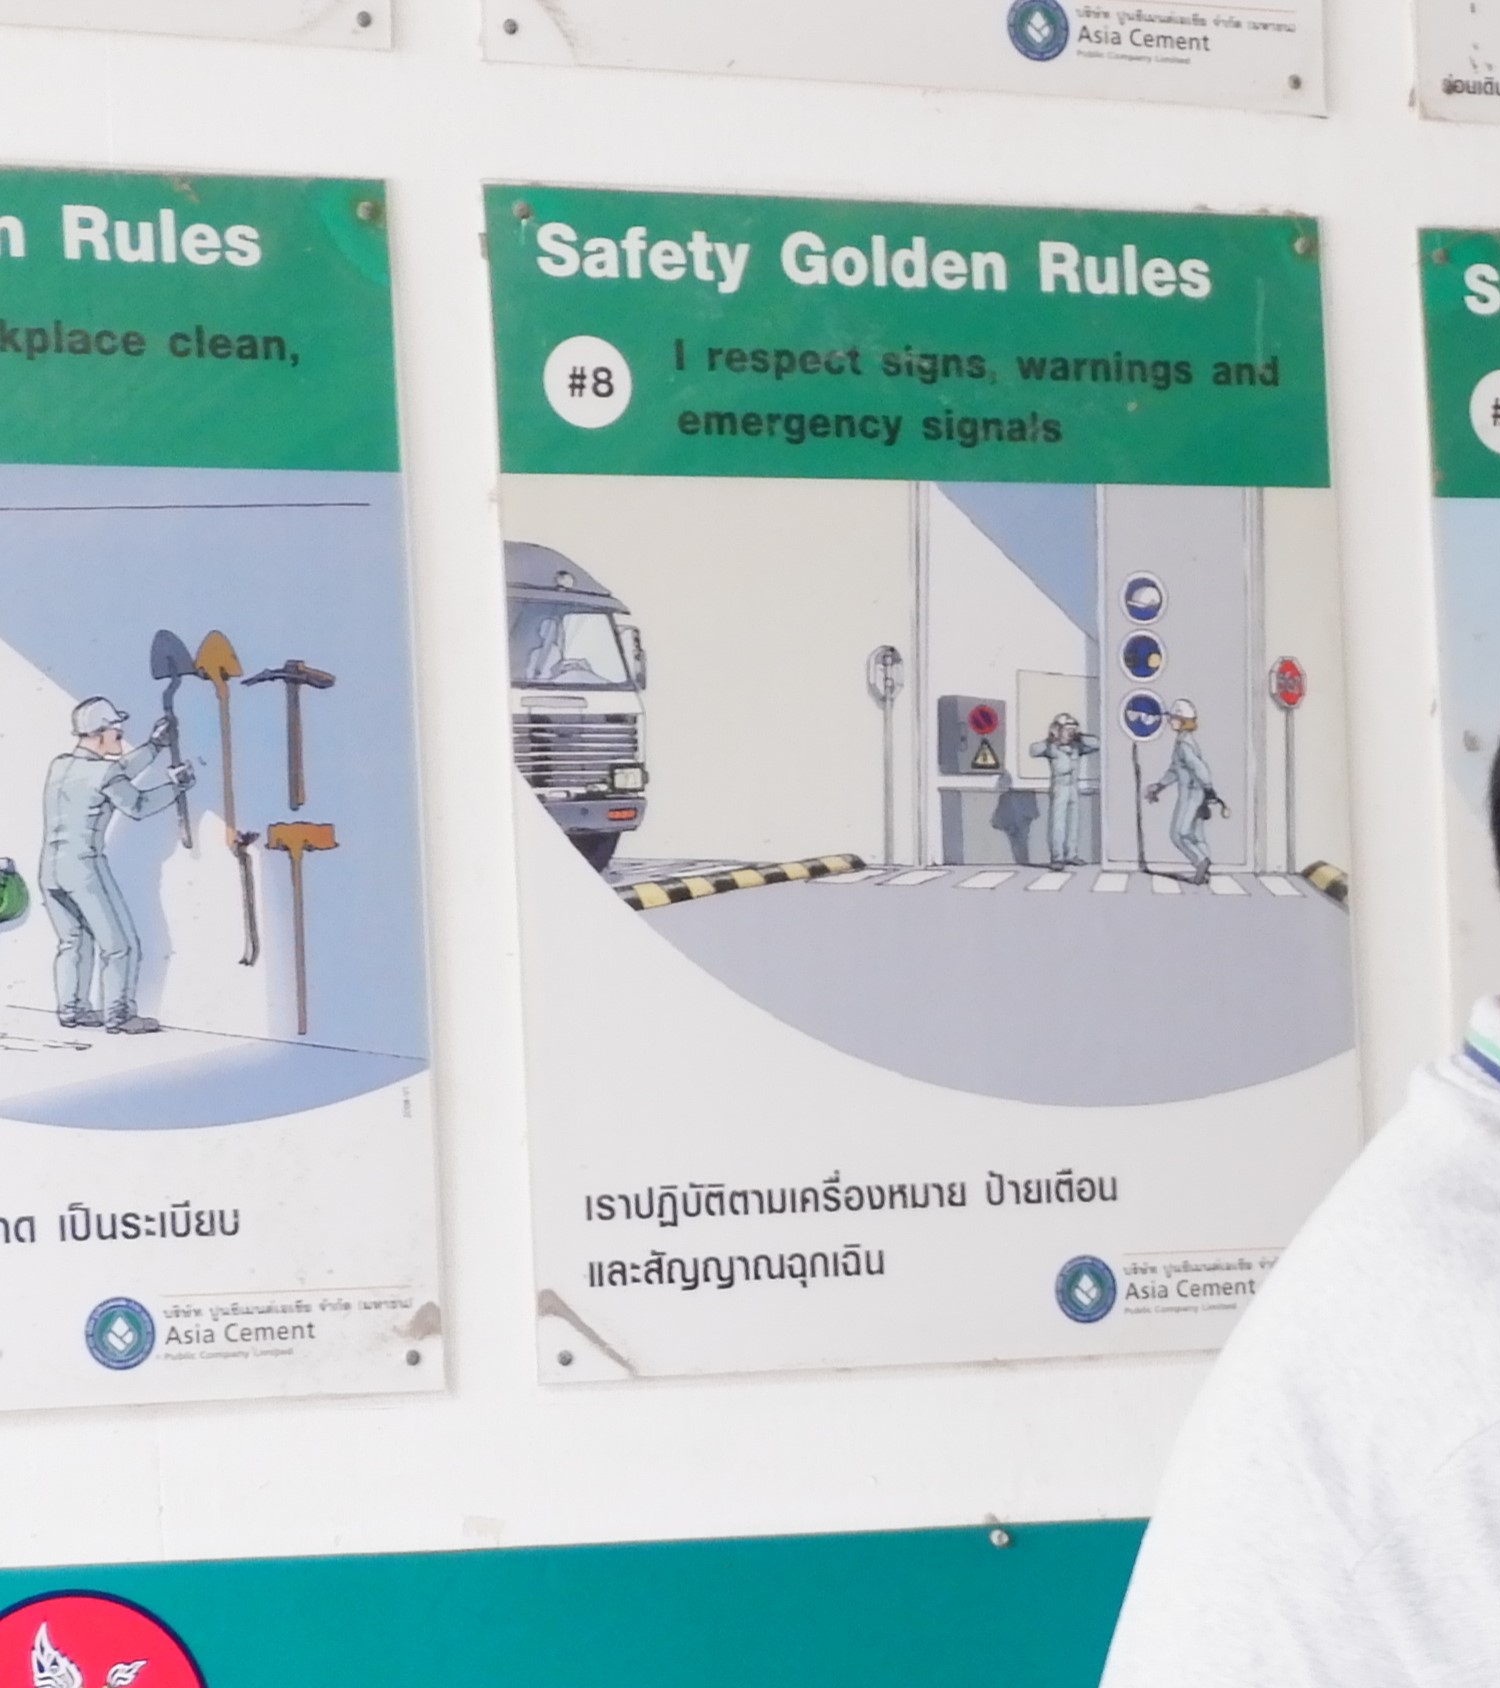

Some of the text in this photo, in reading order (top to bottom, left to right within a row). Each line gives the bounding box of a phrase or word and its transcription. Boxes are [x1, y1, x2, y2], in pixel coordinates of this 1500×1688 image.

[1077, 25, 1211, 51] Asia Cement
[61, 204, 262, 267] Rules
[536, 222, 1213, 300] Safety Golden Rules
[168, 324, 300, 368] clean,
[673, 339, 685, 373] I
[707, 344, 862, 381] respect
[1017, 351, 1193, 389] warnings
[1212, 352, 1281, 388] and
[567, 365, 615, 398] #8
[677, 409, 1063, 447] emergency signals
[585, 1168, 1118, 1227] เราปฏิบัติตามเครื่องหมาย ป้ายเตือน
[58, 1201, 240, 1243] เป็นระเบียบ
[588, 1244, 885, 1291] และสัญญาณฉุกเฉิน
[1124, 1277, 1256, 1300] Asia Cement
[165, 1320, 316, 1345] Asia Cement
